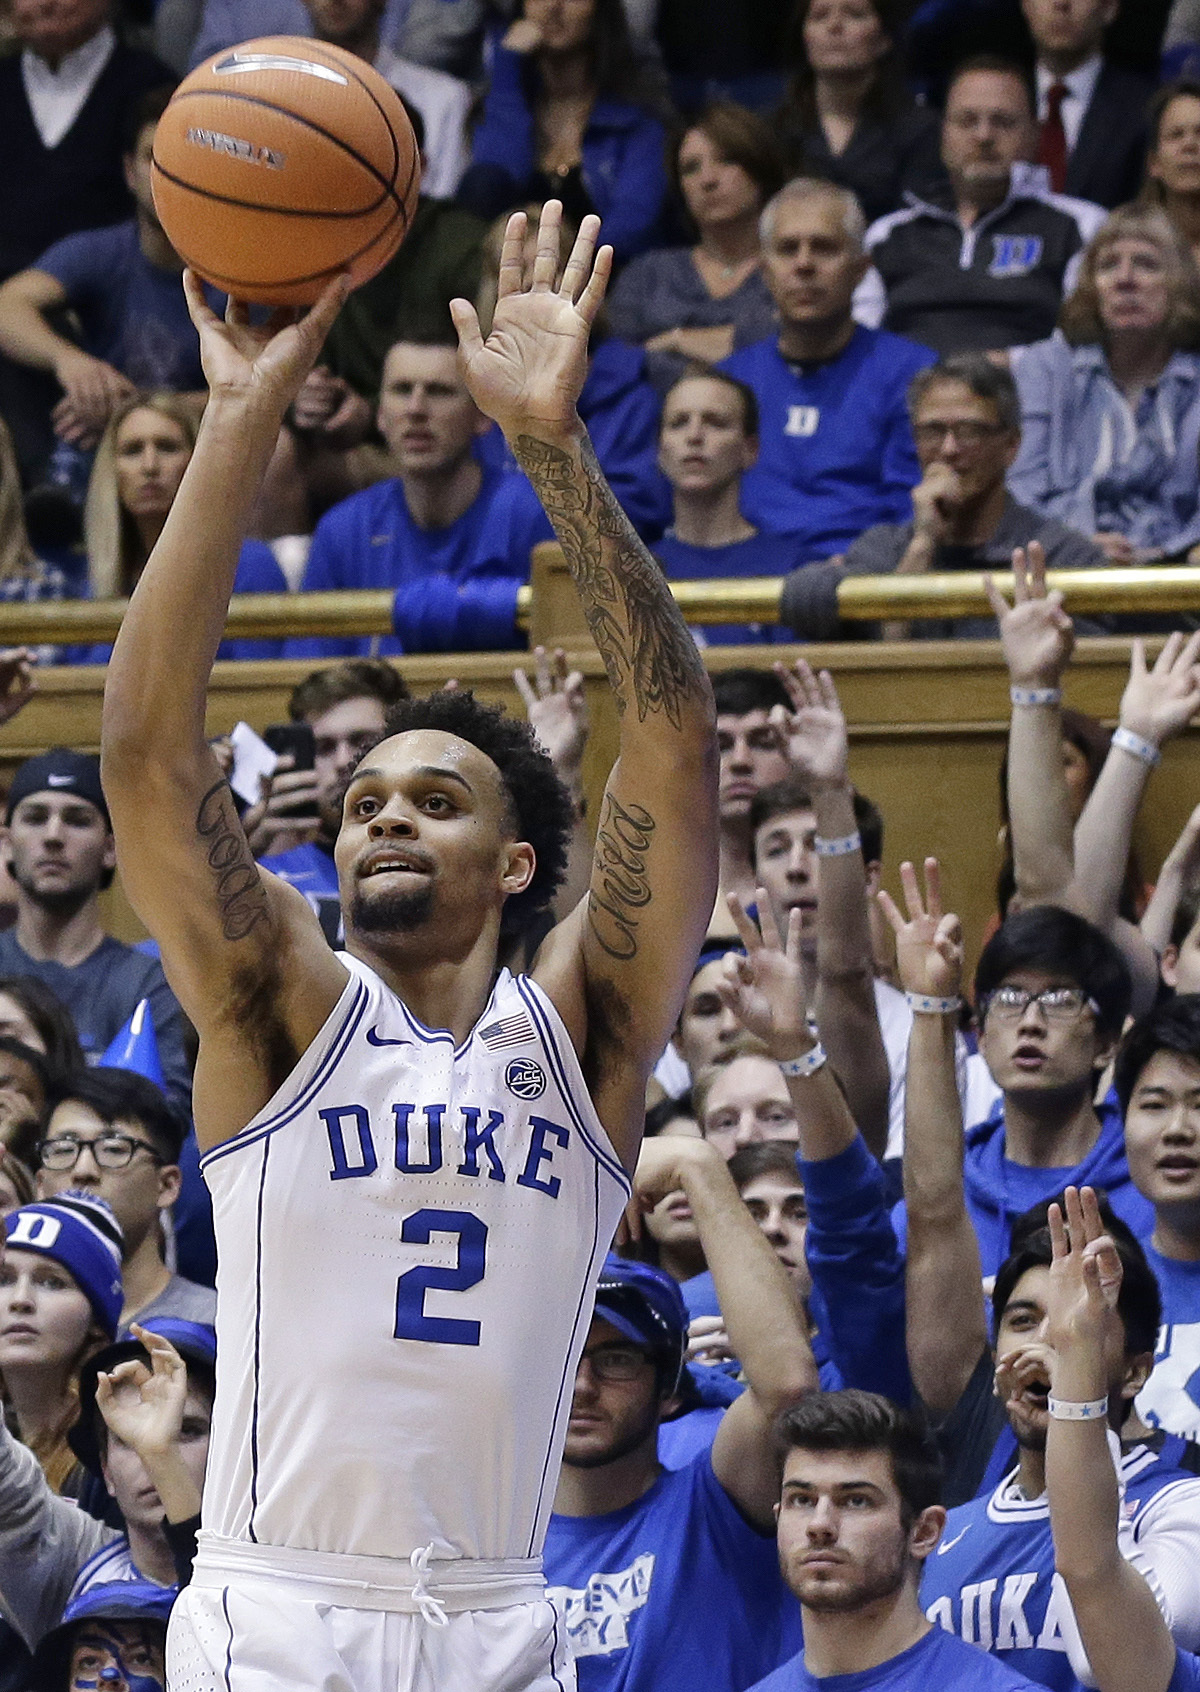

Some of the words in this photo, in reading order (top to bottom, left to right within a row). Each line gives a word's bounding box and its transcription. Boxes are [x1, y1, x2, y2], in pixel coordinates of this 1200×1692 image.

[988, 233, 1044, 279] D
[783, 405, 820, 437] D
[318, 1103, 570, 1200] DUKE
[6, 1211, 63, 1249] D
[393, 1208, 489, 1346] 2
